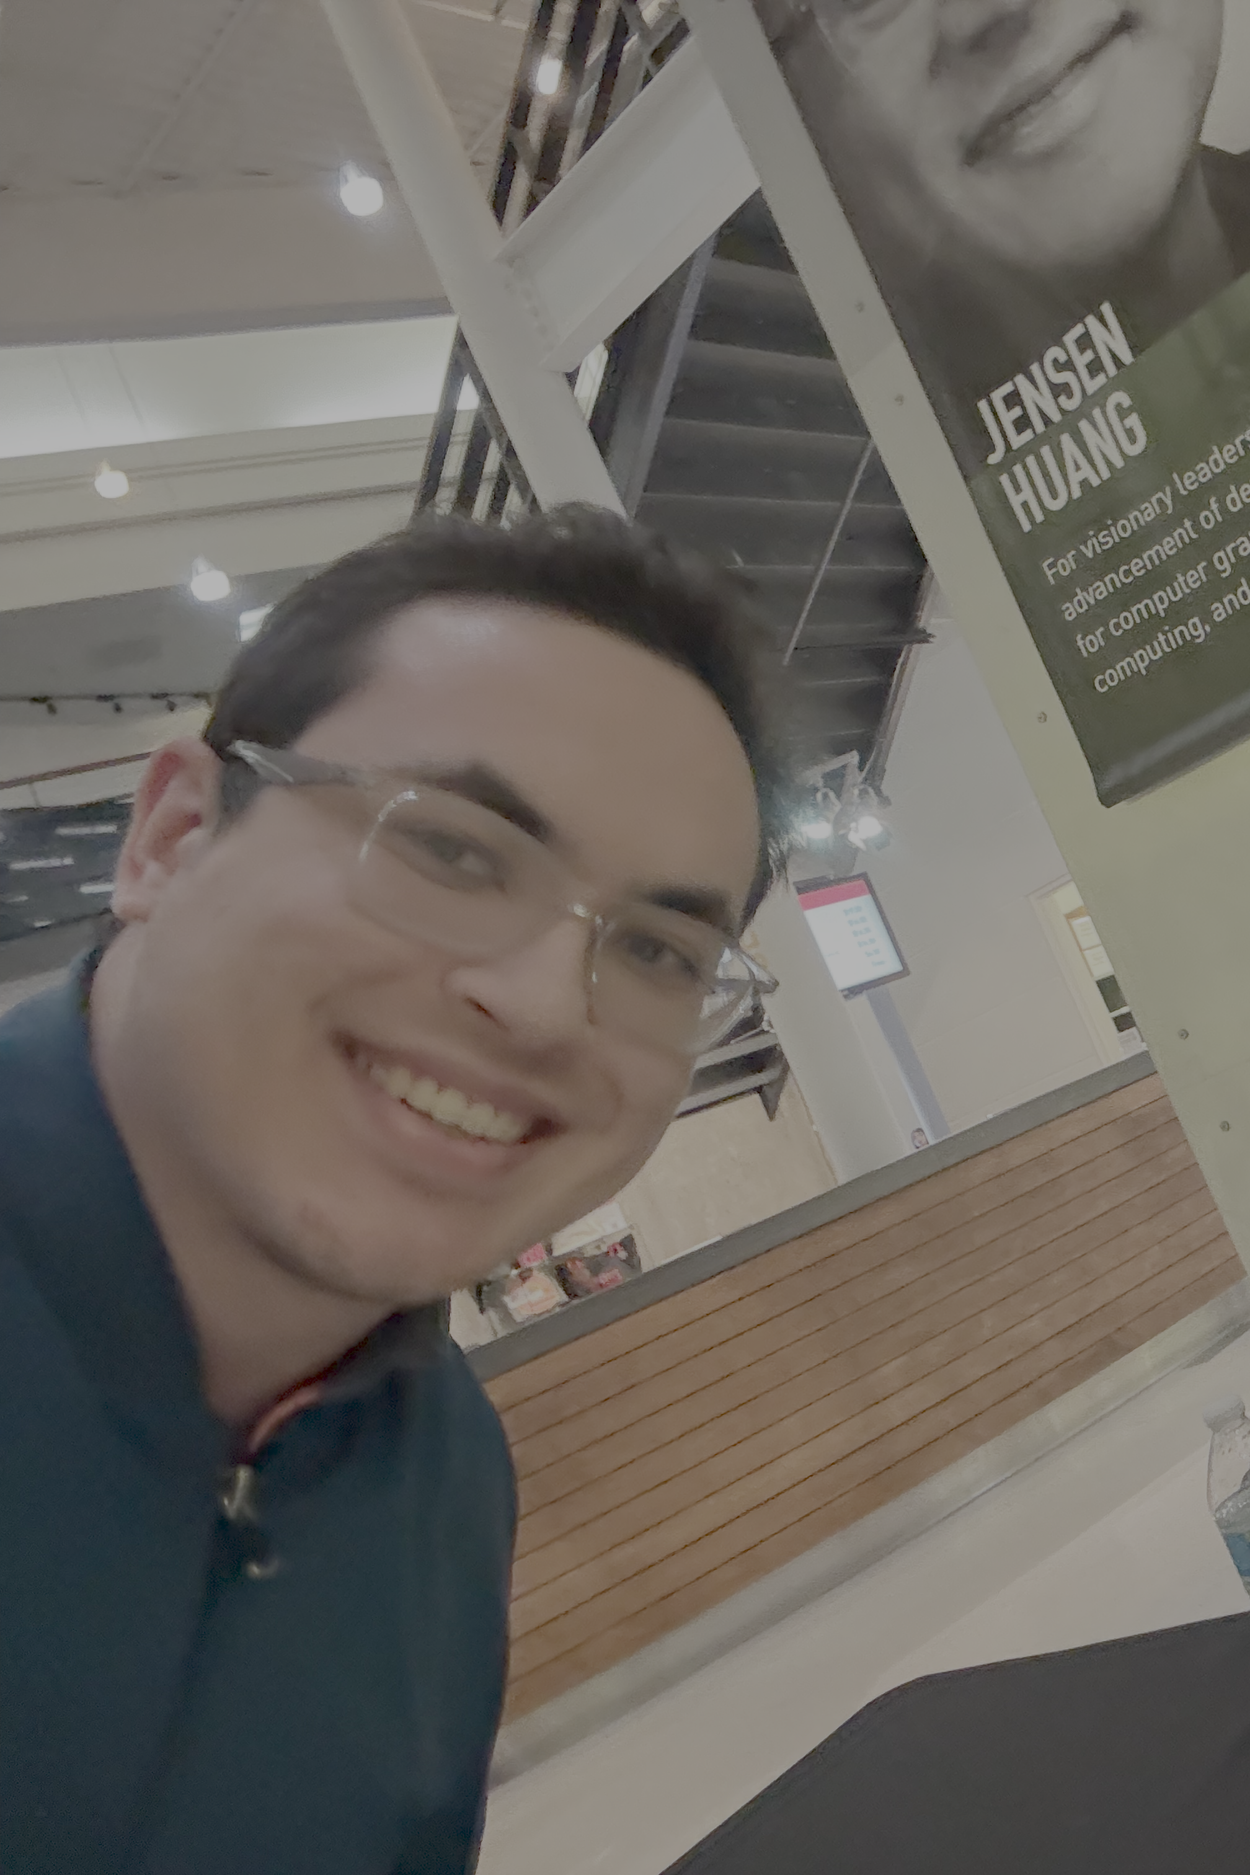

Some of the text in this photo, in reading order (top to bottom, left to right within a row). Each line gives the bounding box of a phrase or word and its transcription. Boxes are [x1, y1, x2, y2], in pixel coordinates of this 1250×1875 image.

[978, 302, 1135, 465] JENSEN
[999, 390, 1147, 533] HUANG
[1042, 550, 1077, 585] For
[1079, 486, 1173, 559] visionary
[1061, 518, 1199, 621] advancement
[1199, 496, 1223, 530] of
[1076, 626, 1105, 657] for
[1108, 561, 1207, 636] computer
[1094, 616, 1211, 693] computing,
